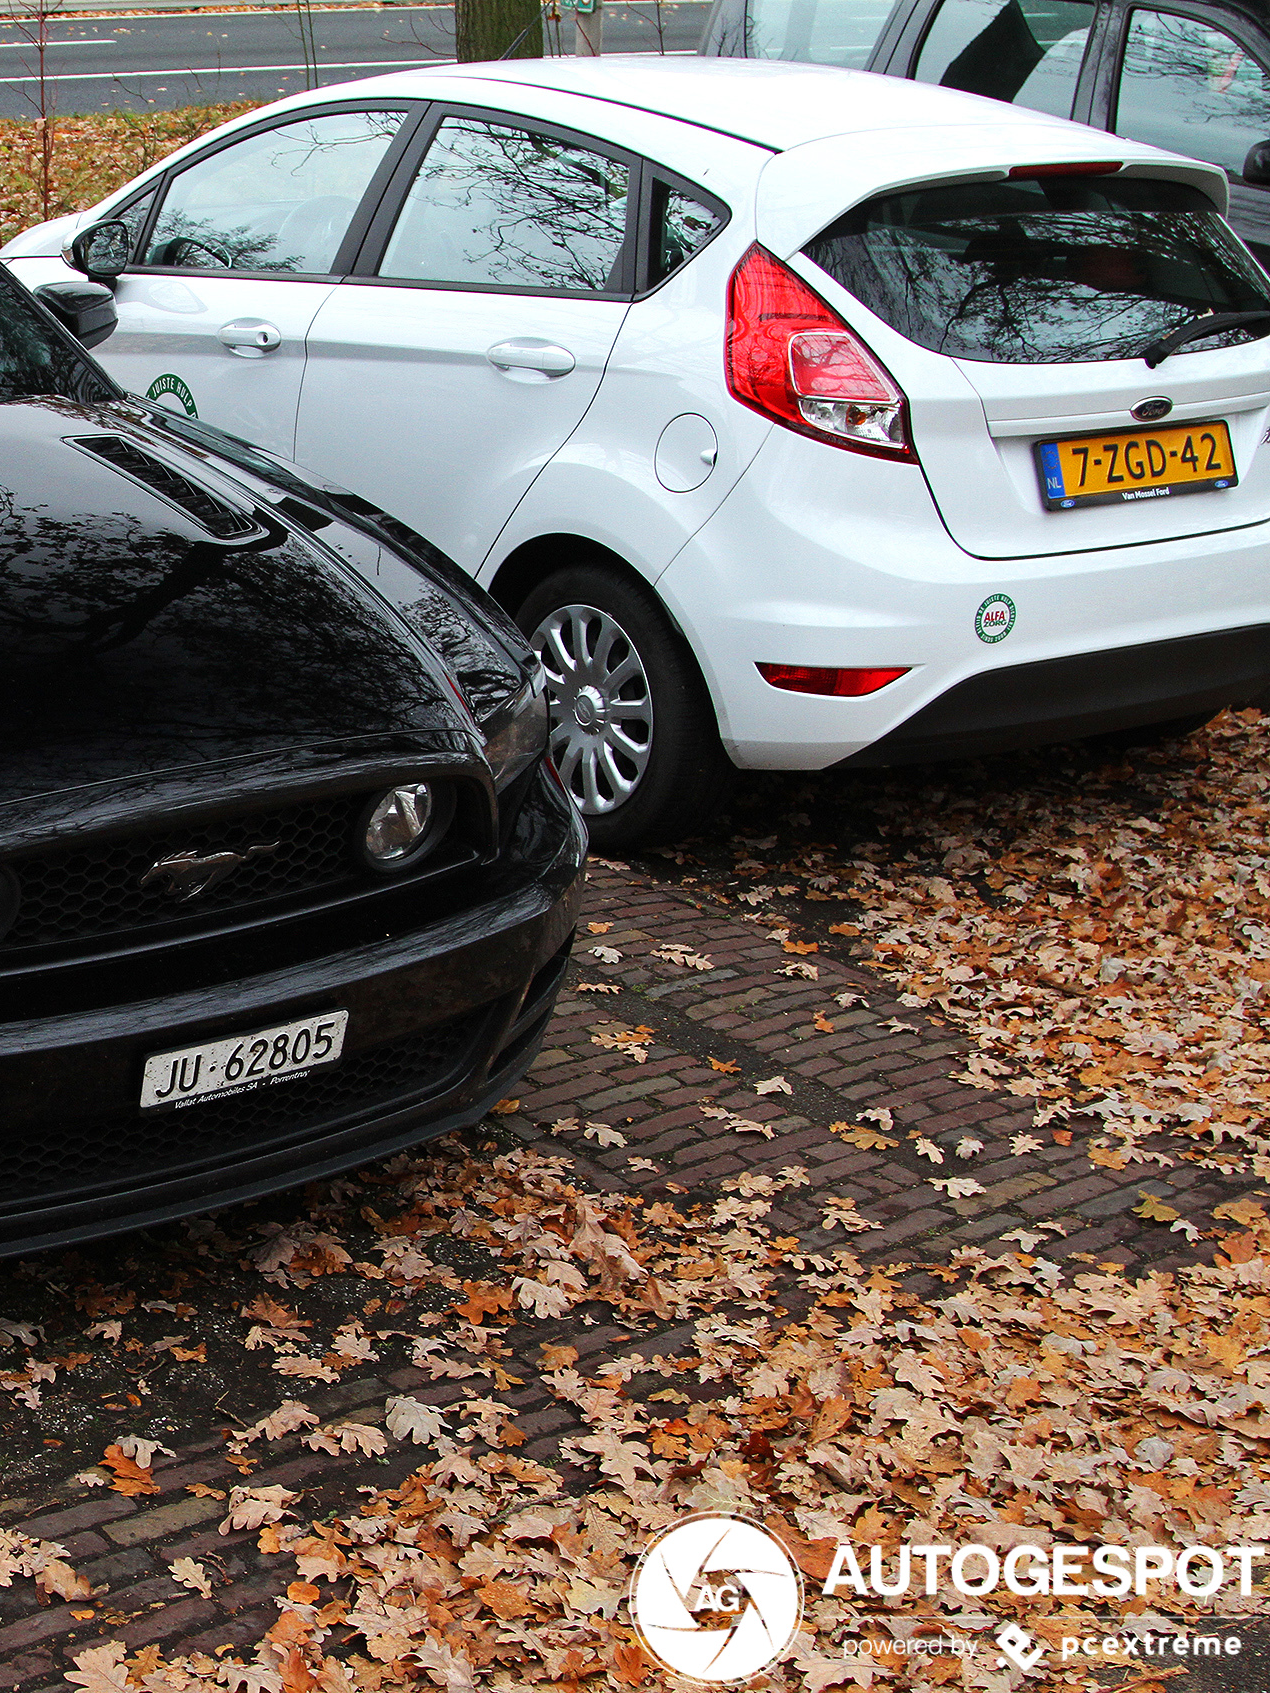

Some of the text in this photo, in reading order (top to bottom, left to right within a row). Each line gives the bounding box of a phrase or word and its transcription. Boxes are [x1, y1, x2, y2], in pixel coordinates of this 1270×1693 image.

[151, 377, 193, 407] JUISTE HULP
[1072, 432, 1222, 488] 7-ZGD-42
[1046, 476, 1063, 490] NL
[1122, 486, 1170, 500] Van Mossel Ford
[983, 620, 1007, 628] ZORG
[984, 610, 1006, 622] ALFA
[156, 1021, 335, 1098] JU 62805
[174, 1069, 310, 1109] Vallat Automobiles SA Porrentruy
